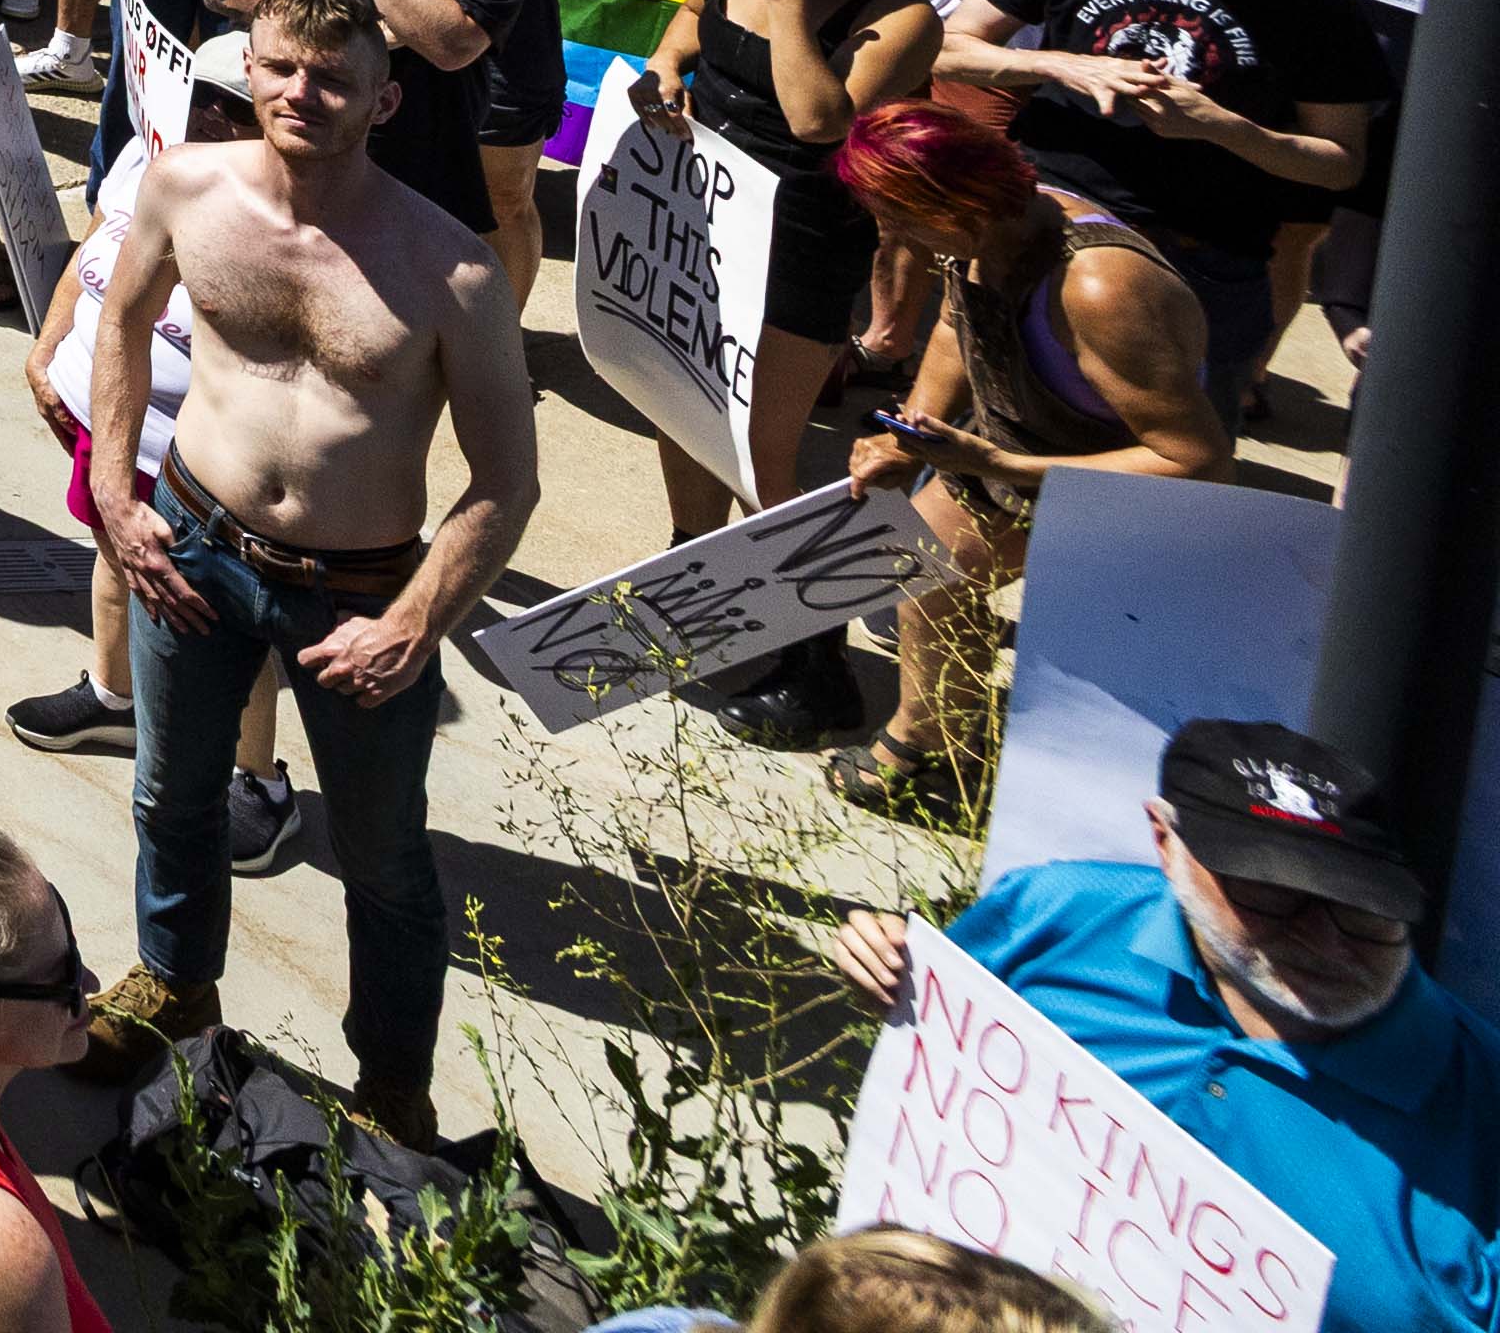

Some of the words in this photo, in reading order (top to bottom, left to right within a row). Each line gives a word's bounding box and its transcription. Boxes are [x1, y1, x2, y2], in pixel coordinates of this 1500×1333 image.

[1208, 8, 1234, 28] IS
[1223, 23, 1259, 68] FINE
[589, 209, 754, 412] VIOLENCE
[630, 181, 722, 305] THIS
[745, 493, 925, 613] NO
[887, 1104, 1010, 1255] NO
[901, 1033, 1015, 1171] NO
[1064, 1175, 1235, 1333] ICE
[918, 963, 1030, 1095] NO
[1048, 1072, 1302, 1323] KINGS
